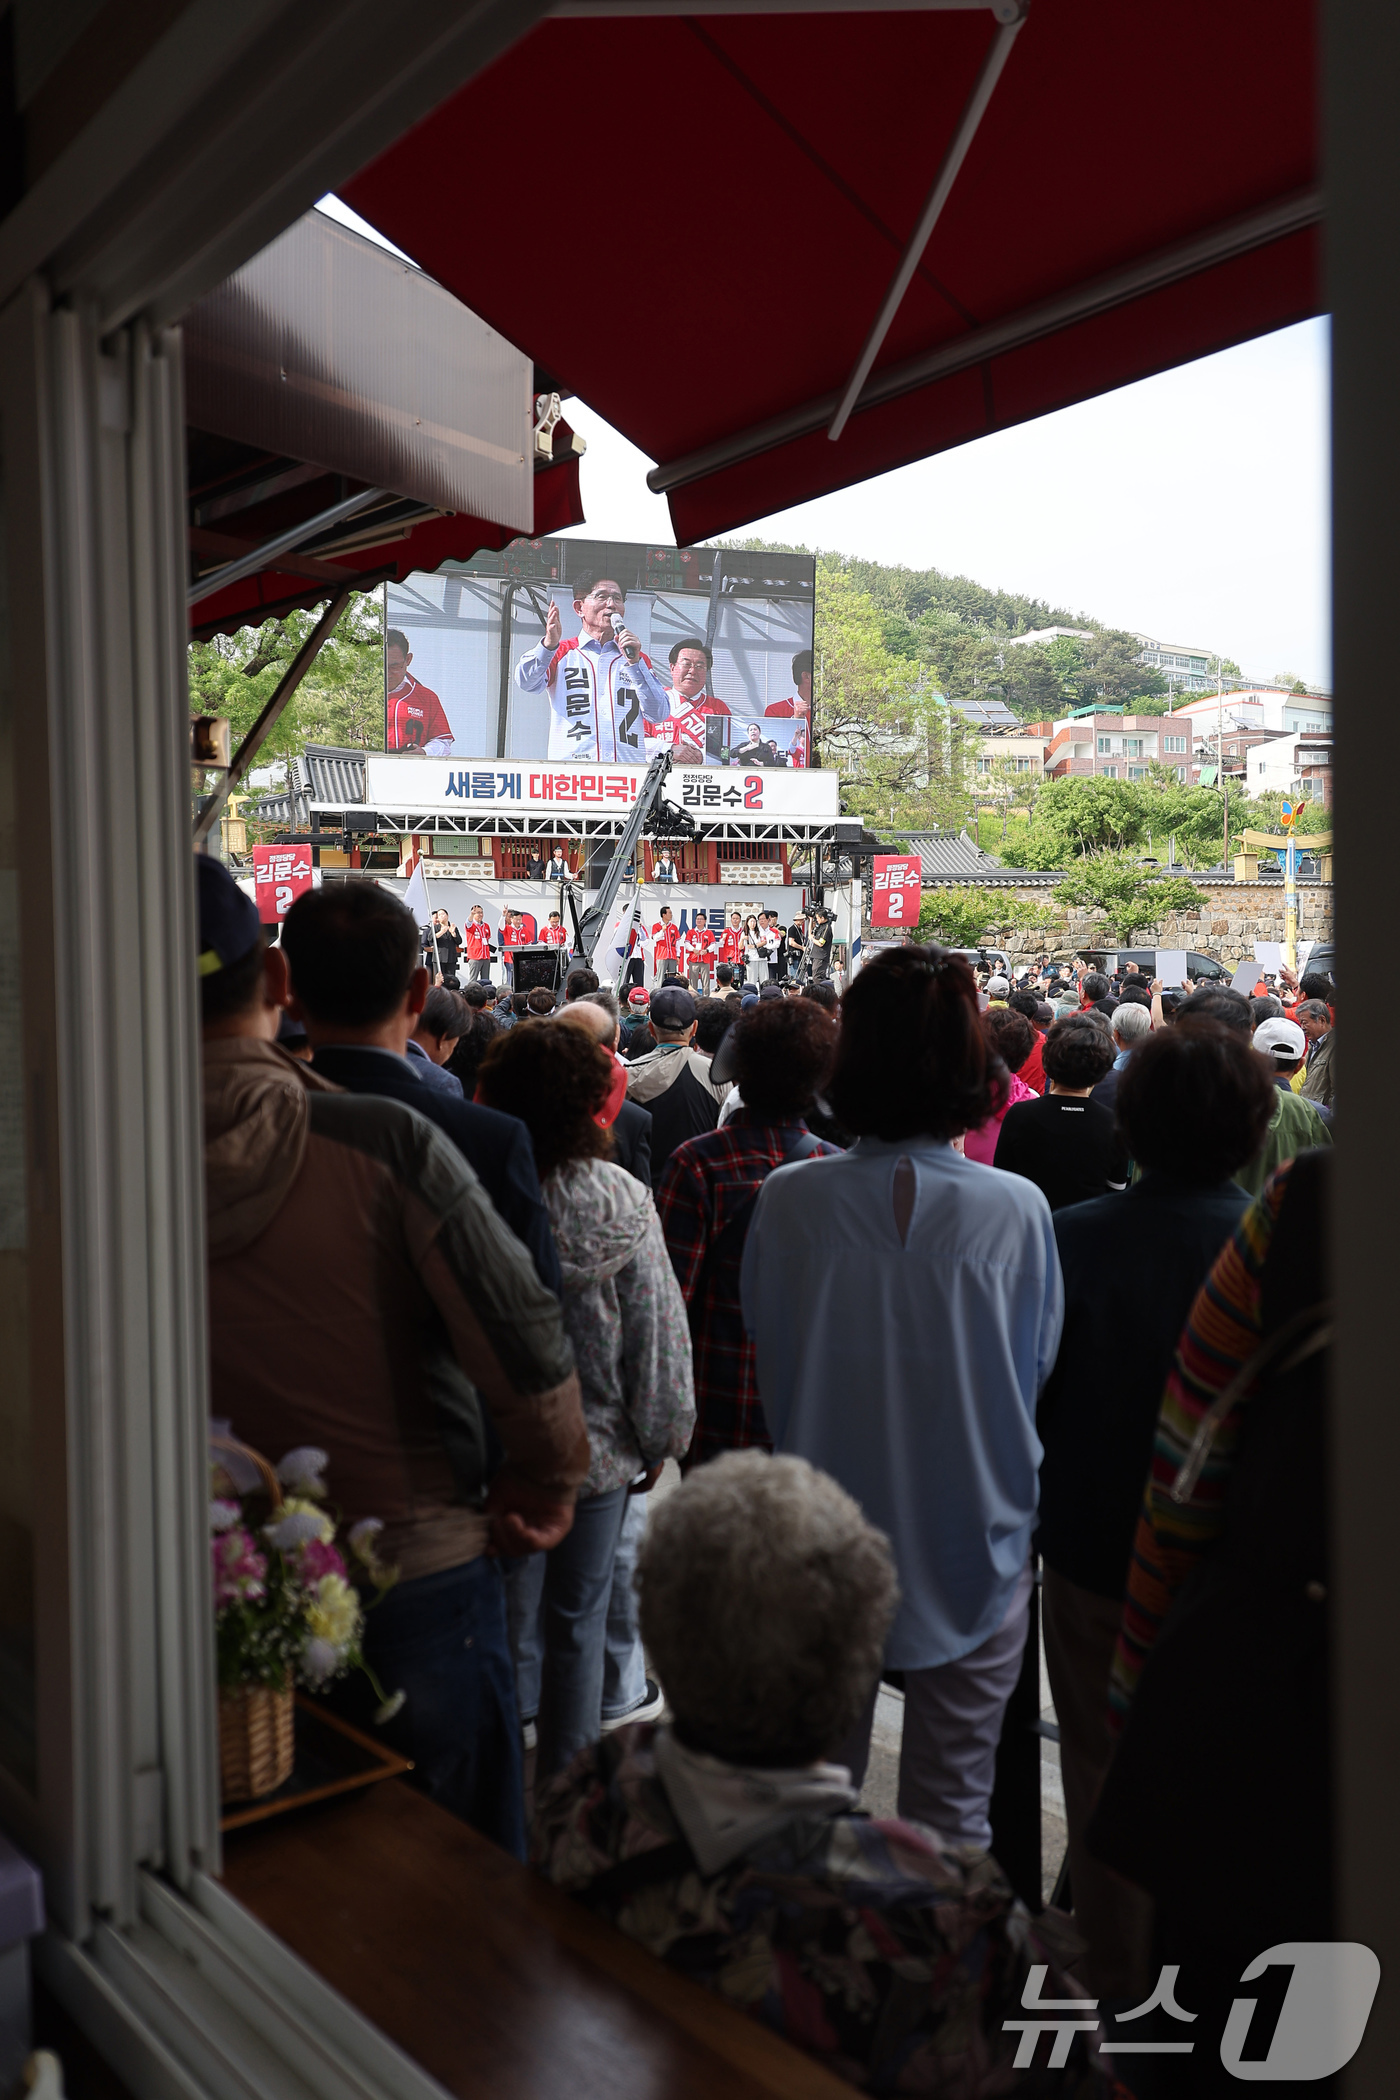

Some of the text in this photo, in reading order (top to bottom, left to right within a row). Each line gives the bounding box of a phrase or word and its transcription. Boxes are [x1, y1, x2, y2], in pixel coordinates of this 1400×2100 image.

[564, 667, 591, 741] 김문수
[617, 687, 639, 749] 2
[445, 772, 637, 802] 새롭게 대한민국!
[682, 773, 713, 783] 정정당당
[682, 775, 763, 809] 김문수 2
[256, 860, 311, 884] 김문수
[874, 869, 920, 890] 김문수
[275, 886, 293, 915] 2
[888, 892, 904, 919] 2
